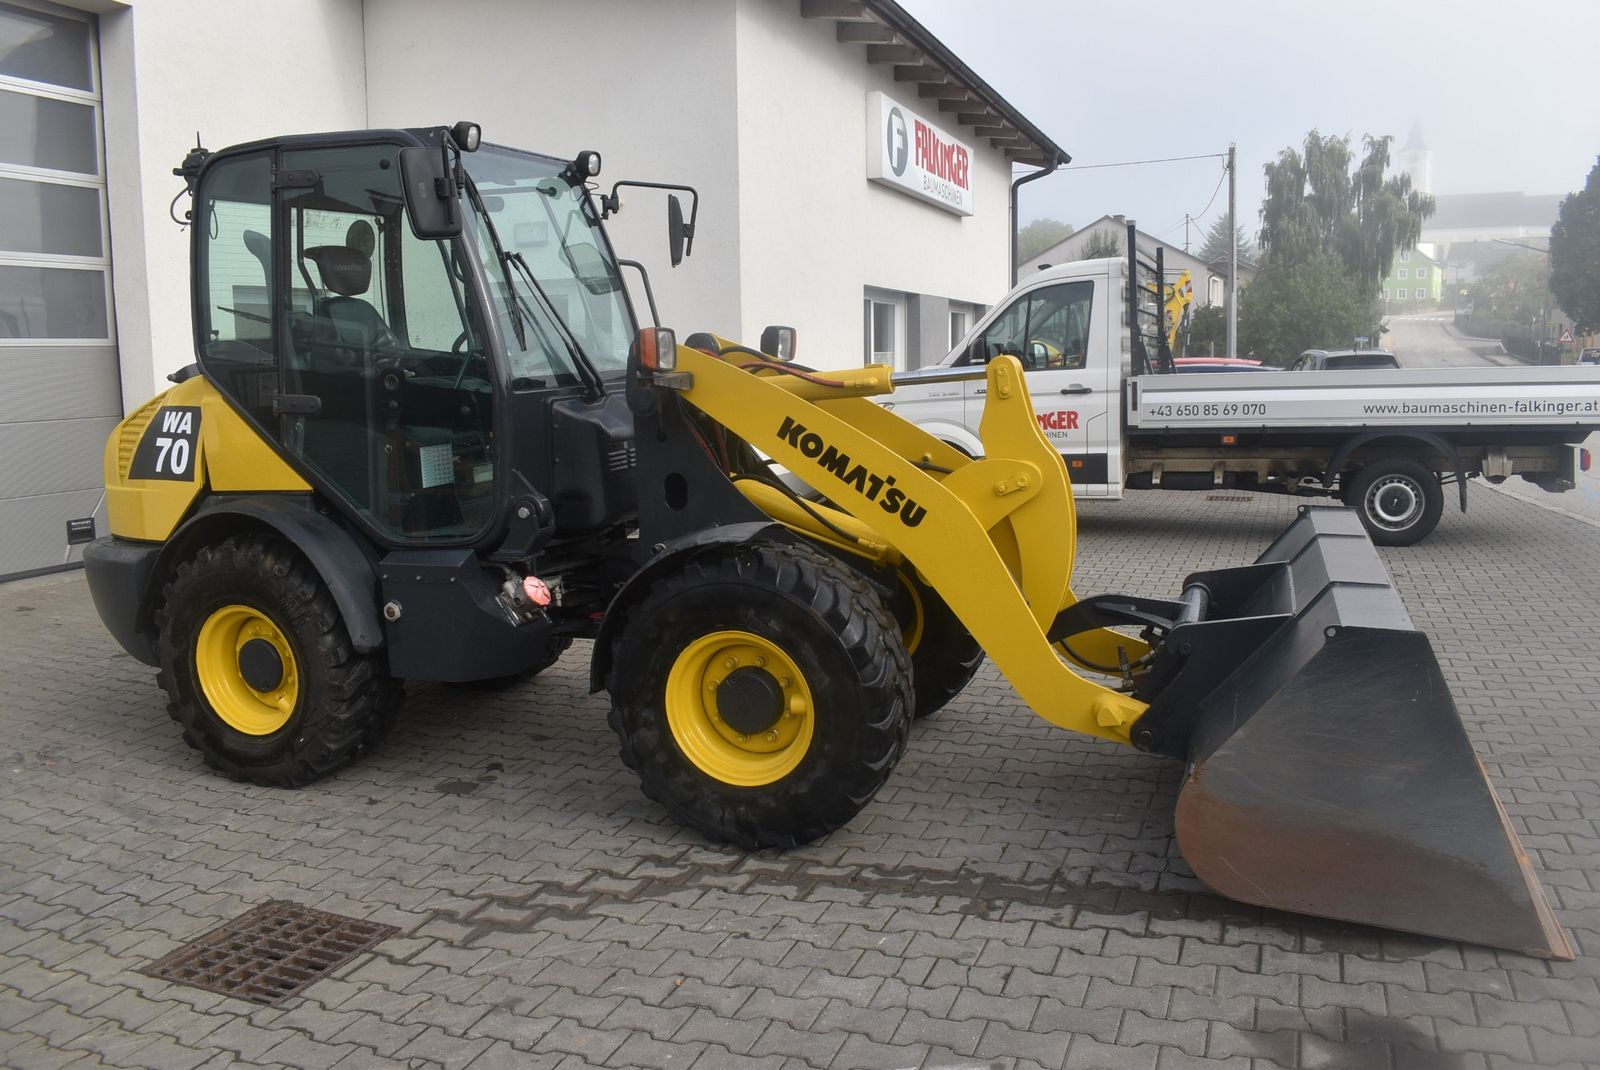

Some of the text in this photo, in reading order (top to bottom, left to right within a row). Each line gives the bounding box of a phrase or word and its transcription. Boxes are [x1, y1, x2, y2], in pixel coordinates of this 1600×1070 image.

[914, 119, 969, 191] FALKINGER
[923, 174, 963, 205] BAUMASCHINEN
[1036, 411, 1079, 430] NGER
[1150, 404, 1266, 417] +43 650 85 69 070
[1363, 400, 1599, 415] www.baumaschinen-falkinger.at
[162, 411, 192, 434] WA
[155, 437, 190, 474] 70
[776, 415, 928, 528] KOMATSU
